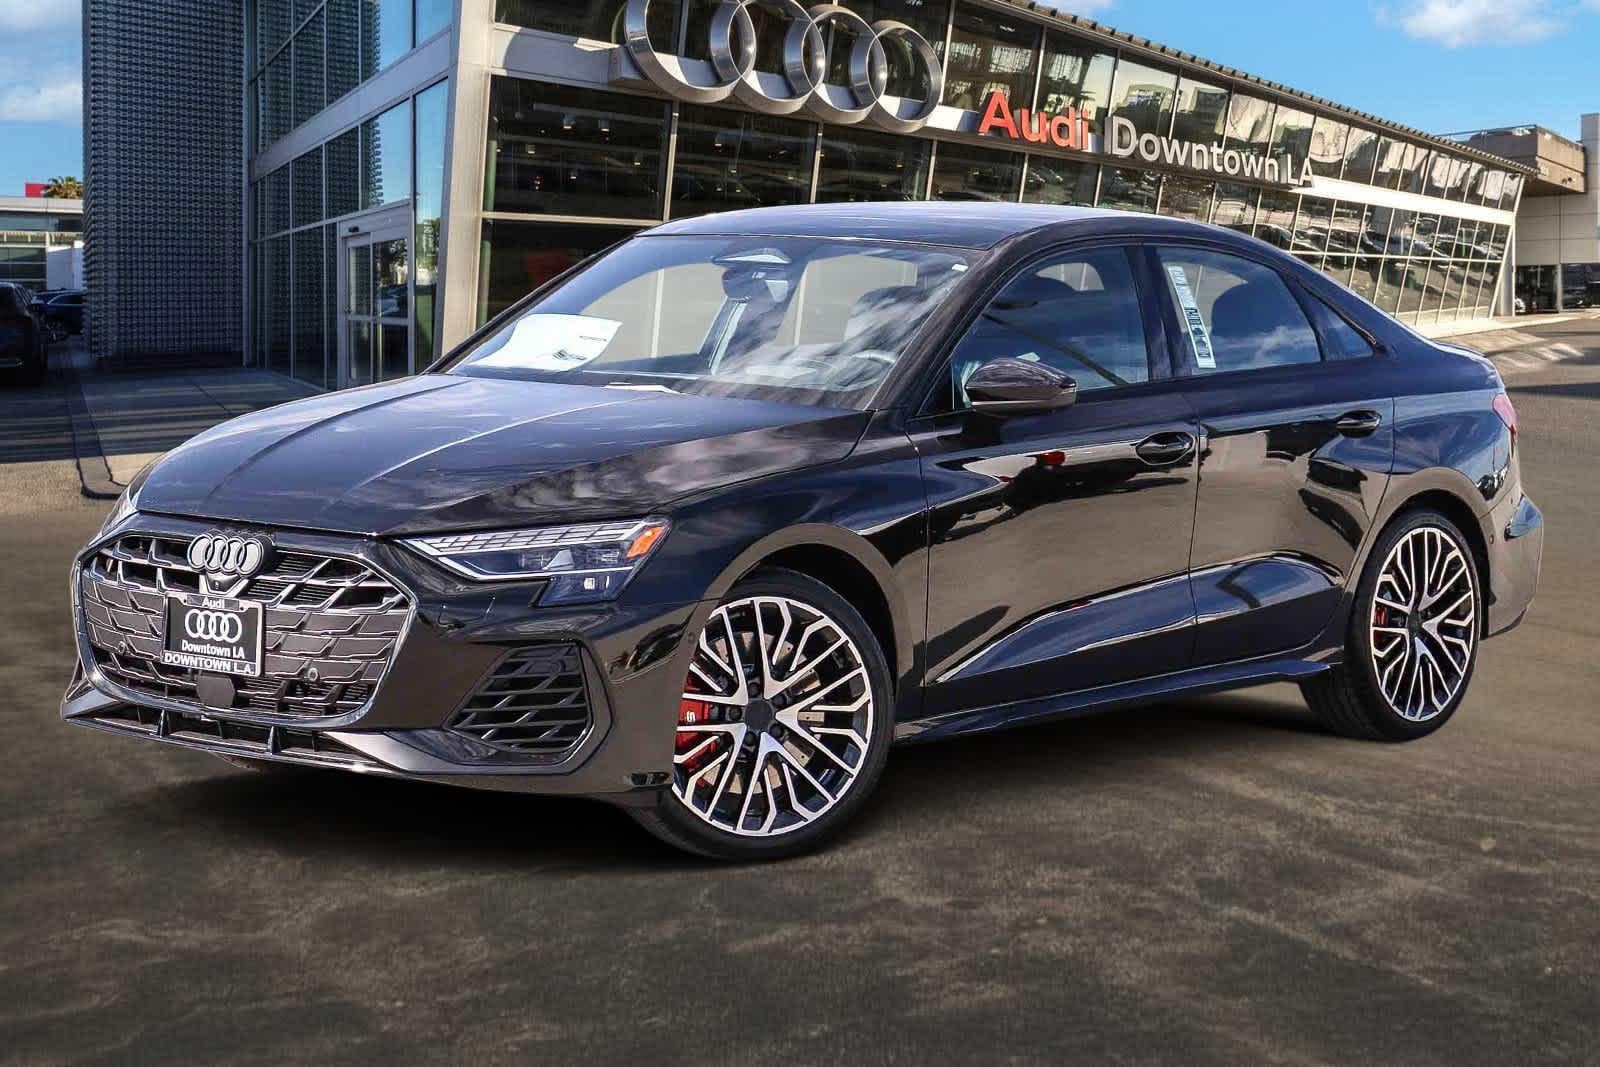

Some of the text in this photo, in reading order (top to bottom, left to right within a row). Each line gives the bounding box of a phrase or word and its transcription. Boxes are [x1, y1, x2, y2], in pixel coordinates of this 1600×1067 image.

[978, 91, 1314, 188] Audi Downtown LA
[201, 596, 225, 609] Audi
[181, 640, 246, 660] Downtown LA
[164, 652, 255, 675] DOWNTOWN L.A.
